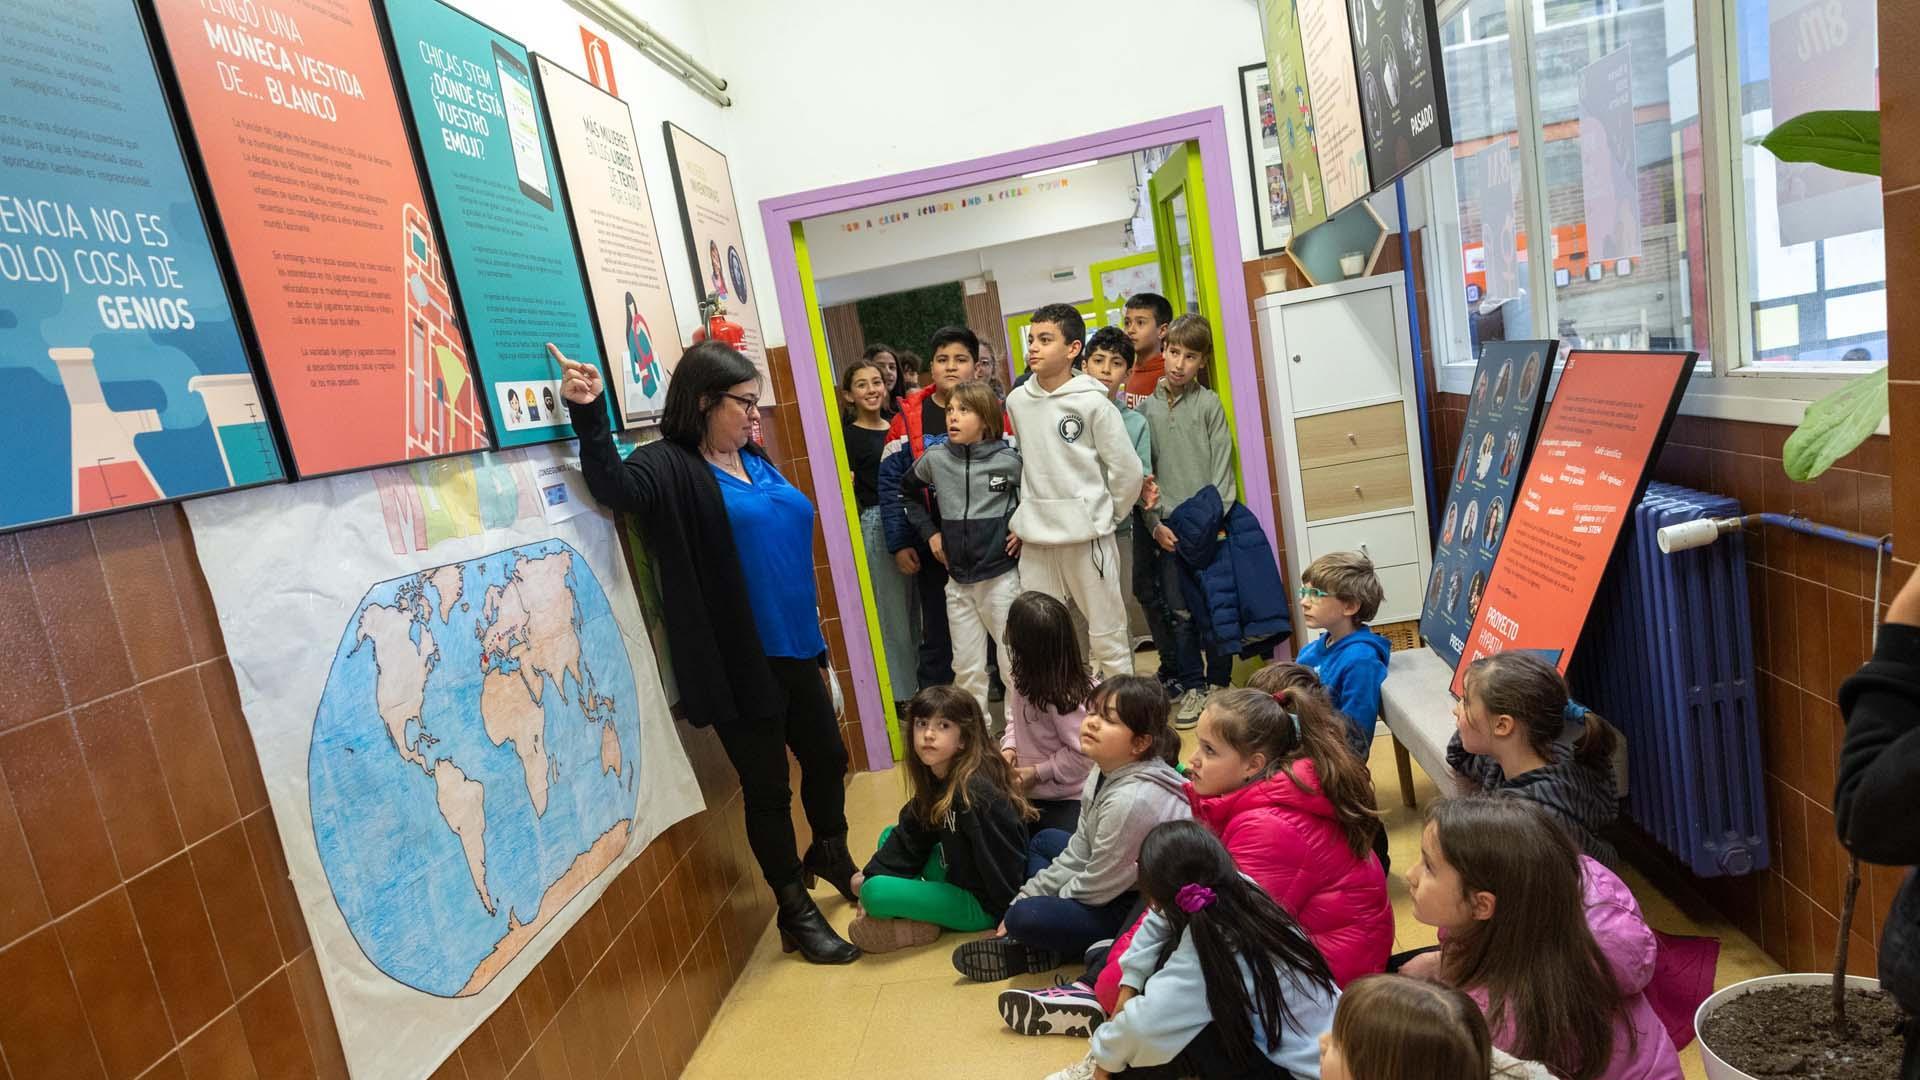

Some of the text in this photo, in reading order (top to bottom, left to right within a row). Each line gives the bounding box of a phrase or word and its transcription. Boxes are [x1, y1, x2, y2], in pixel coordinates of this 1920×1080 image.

[262, 5, 305, 46] UNA
[203, 18, 365, 100] MUÑECA VESTIDA
[419, 40, 494, 91] CHICAS STEM
[265, 76, 338, 123] BLANCO
[432, 98, 491, 137] VUESTRO
[476, 91, 506, 120] ESTÁ
[1410, 103, 1434, 137] PASADO
[440, 127, 487, 161] EMOJI?
[0, 195, 169, 248] ENCIA NO ES
[73, 249, 146, 289] COSA
[149, 255, 184, 289] DE
[97, 295, 196, 330] GENIOS
[1485, 605, 1519, 641] PROYECTO
